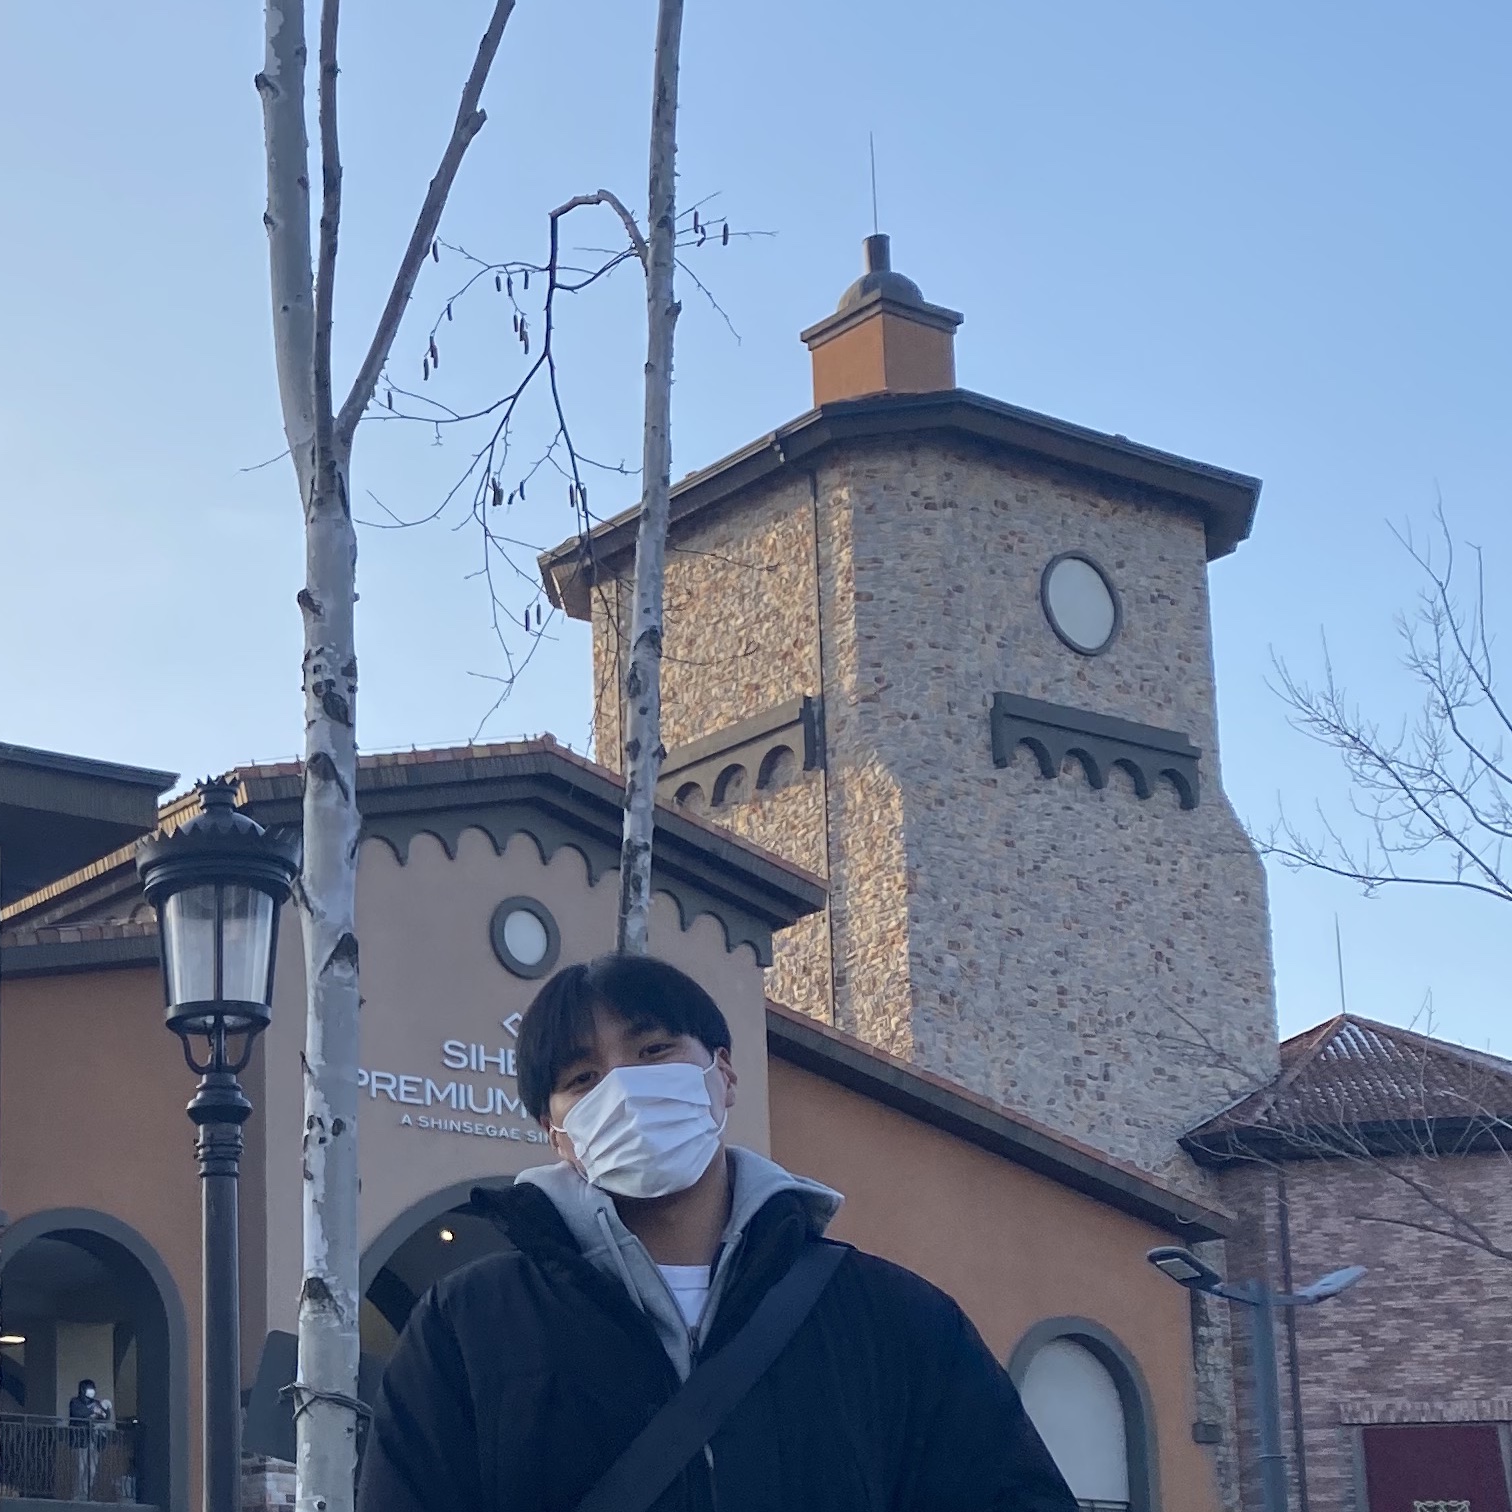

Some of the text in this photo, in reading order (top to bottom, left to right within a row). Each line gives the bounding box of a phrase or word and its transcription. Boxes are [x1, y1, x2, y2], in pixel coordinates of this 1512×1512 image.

[358, 1068, 528, 1120] PREMIUM
[400, 1113, 549, 1144] A SHINSEGAE SI
